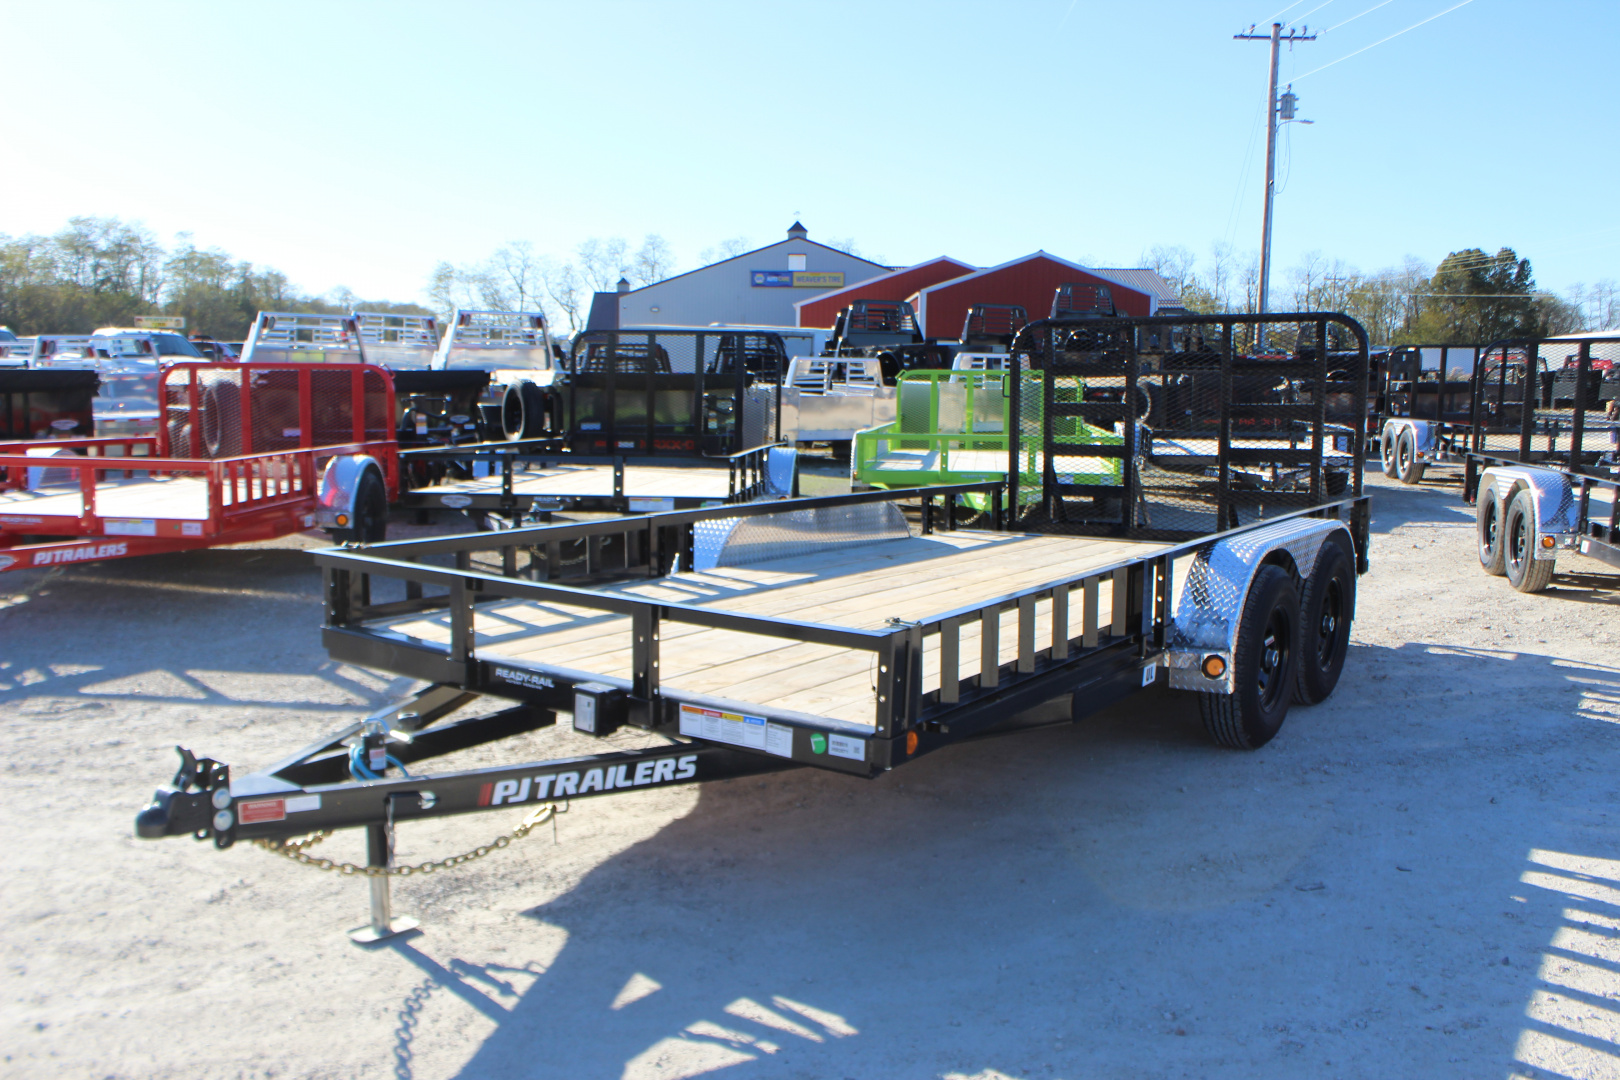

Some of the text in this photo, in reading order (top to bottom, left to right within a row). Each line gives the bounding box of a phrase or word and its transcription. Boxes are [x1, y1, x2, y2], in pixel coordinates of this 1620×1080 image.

[33, 550, 54, 566] PJ
[54, 542, 128, 563] TRAILERS
[495, 667, 555, 688] READY-RAIL
[491, 754, 698, 806] PJ TRAILERS
